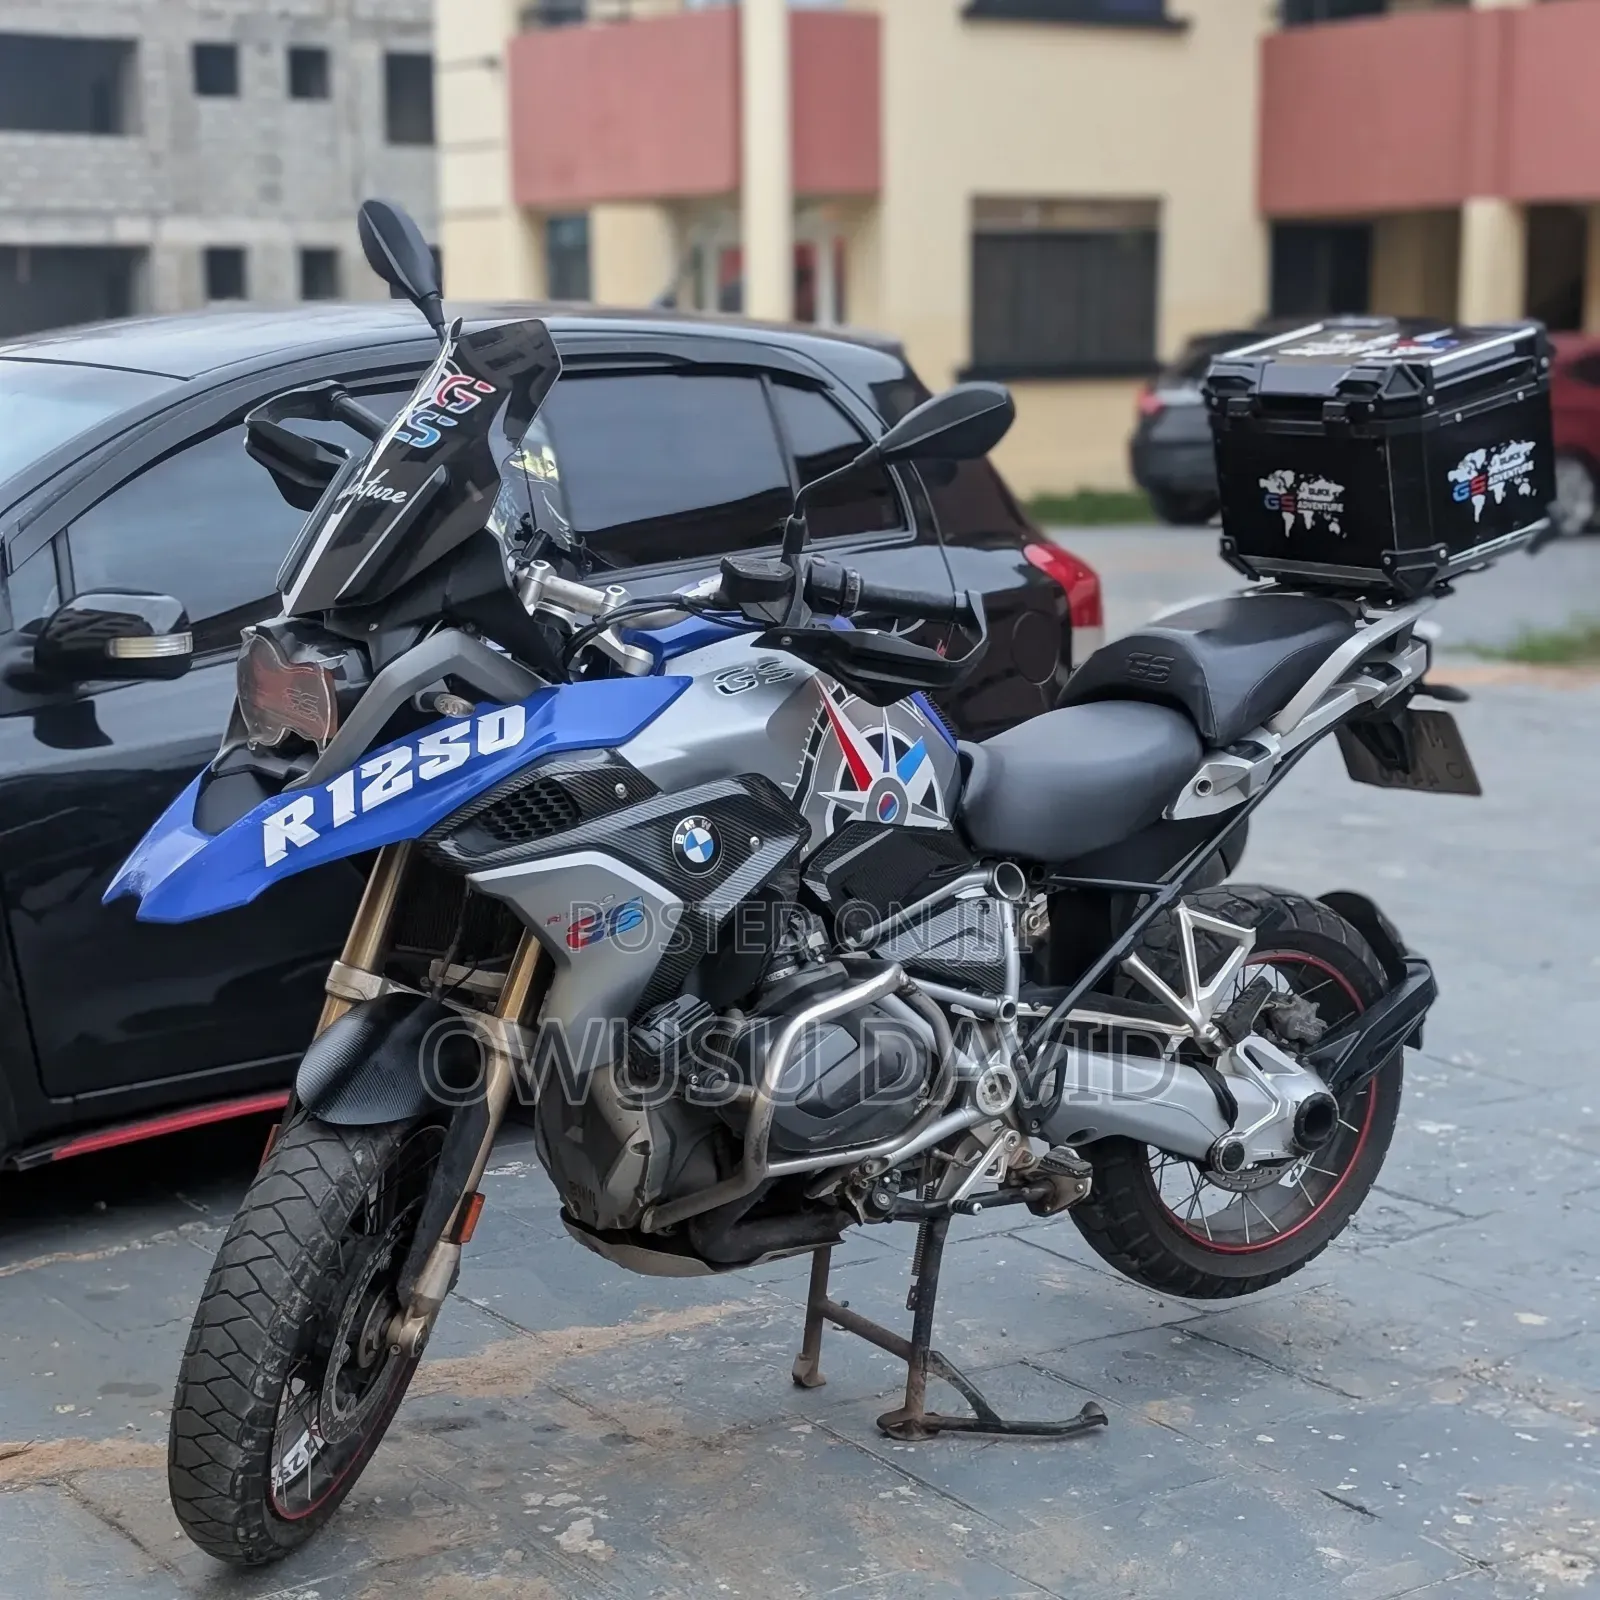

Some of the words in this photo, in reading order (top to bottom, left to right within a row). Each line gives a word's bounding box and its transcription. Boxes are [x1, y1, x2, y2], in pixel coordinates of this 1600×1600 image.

[1452, 473, 1487, 502] GS
[1297, 501, 1344, 513] ADVENTURE
[674, 819, 712, 845] BMW
